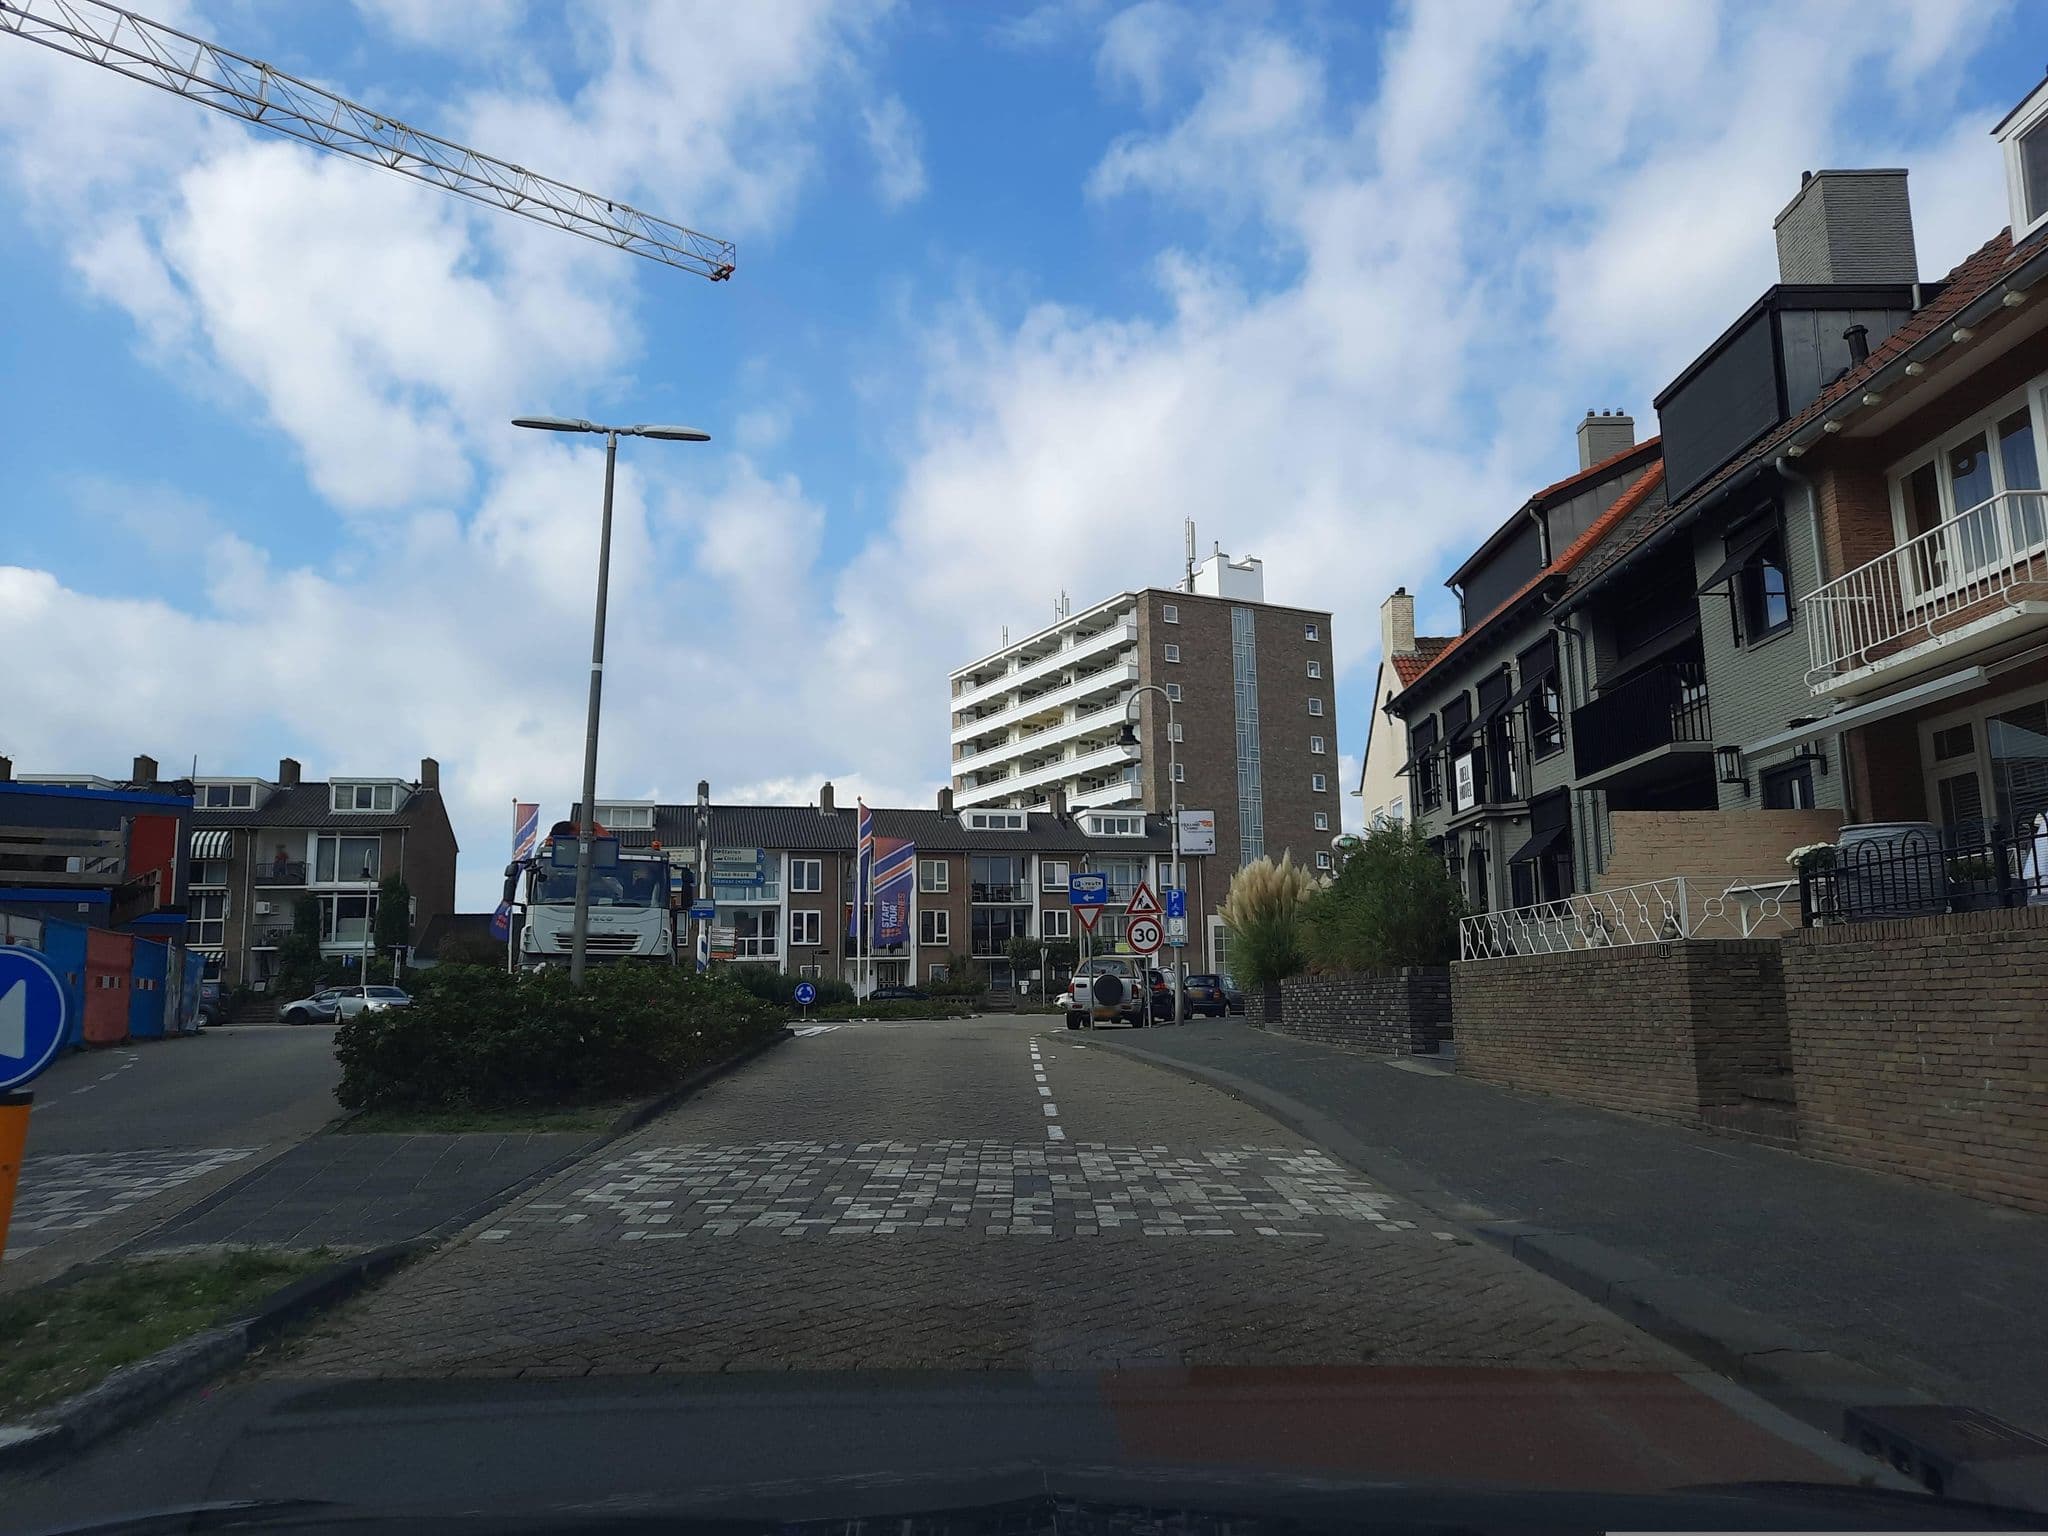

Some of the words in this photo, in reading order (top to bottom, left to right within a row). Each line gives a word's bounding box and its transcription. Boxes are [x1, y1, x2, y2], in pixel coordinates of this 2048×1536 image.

[1171, 892, 1179, 903] P
[881, 900, 890, 928] START
[889, 904, 898, 928] YOUR
[1134, 928, 1157, 943] 30
[1660, 944, 1667, 956] 11
